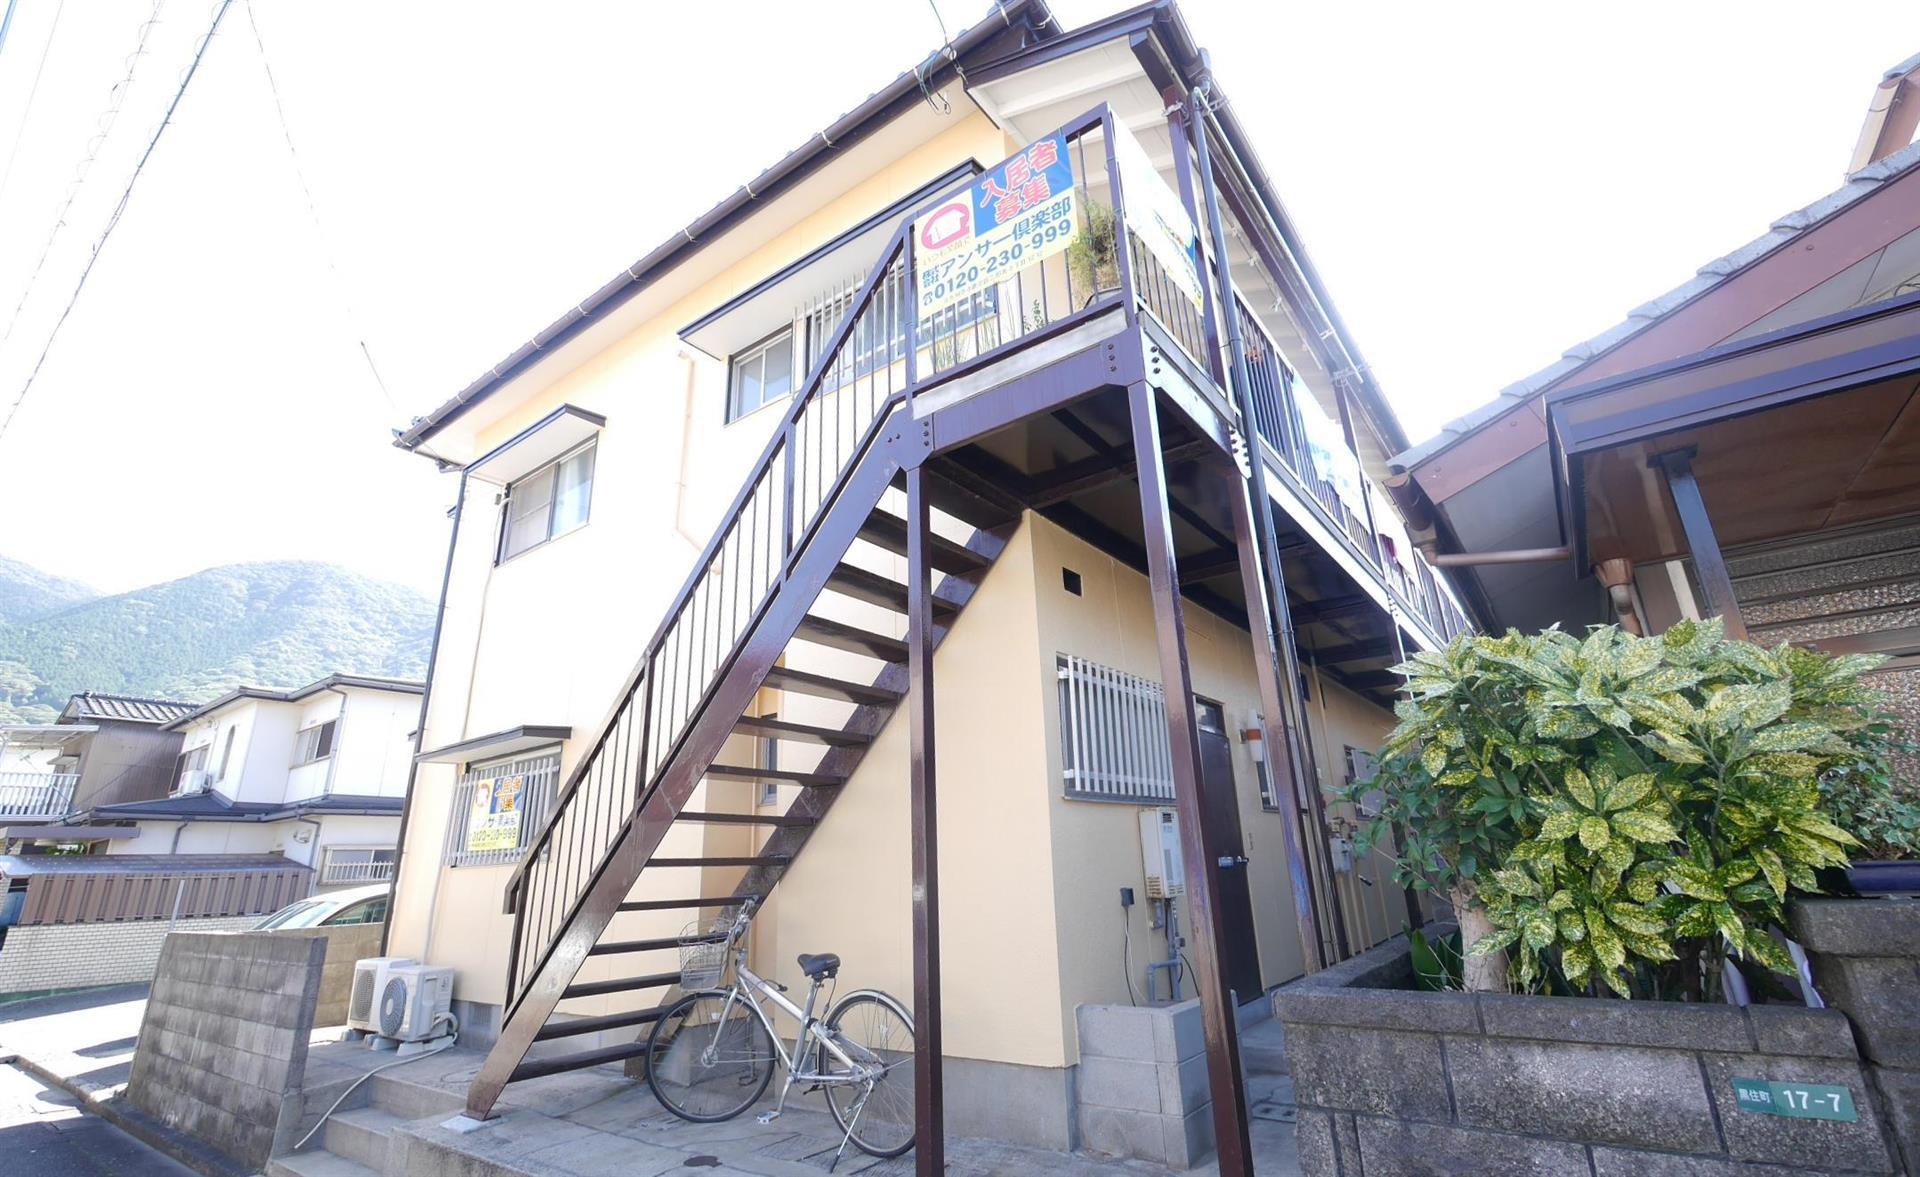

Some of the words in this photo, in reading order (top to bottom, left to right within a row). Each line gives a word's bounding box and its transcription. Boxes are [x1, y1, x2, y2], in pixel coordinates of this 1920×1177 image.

[980, 139, 1058, 208] 入居者
[995, 172, 1051, 225] 募集
[934, 219, 1071, 299] 0120-230-999
[1783, 1090, 1840, 1112] 17-7
